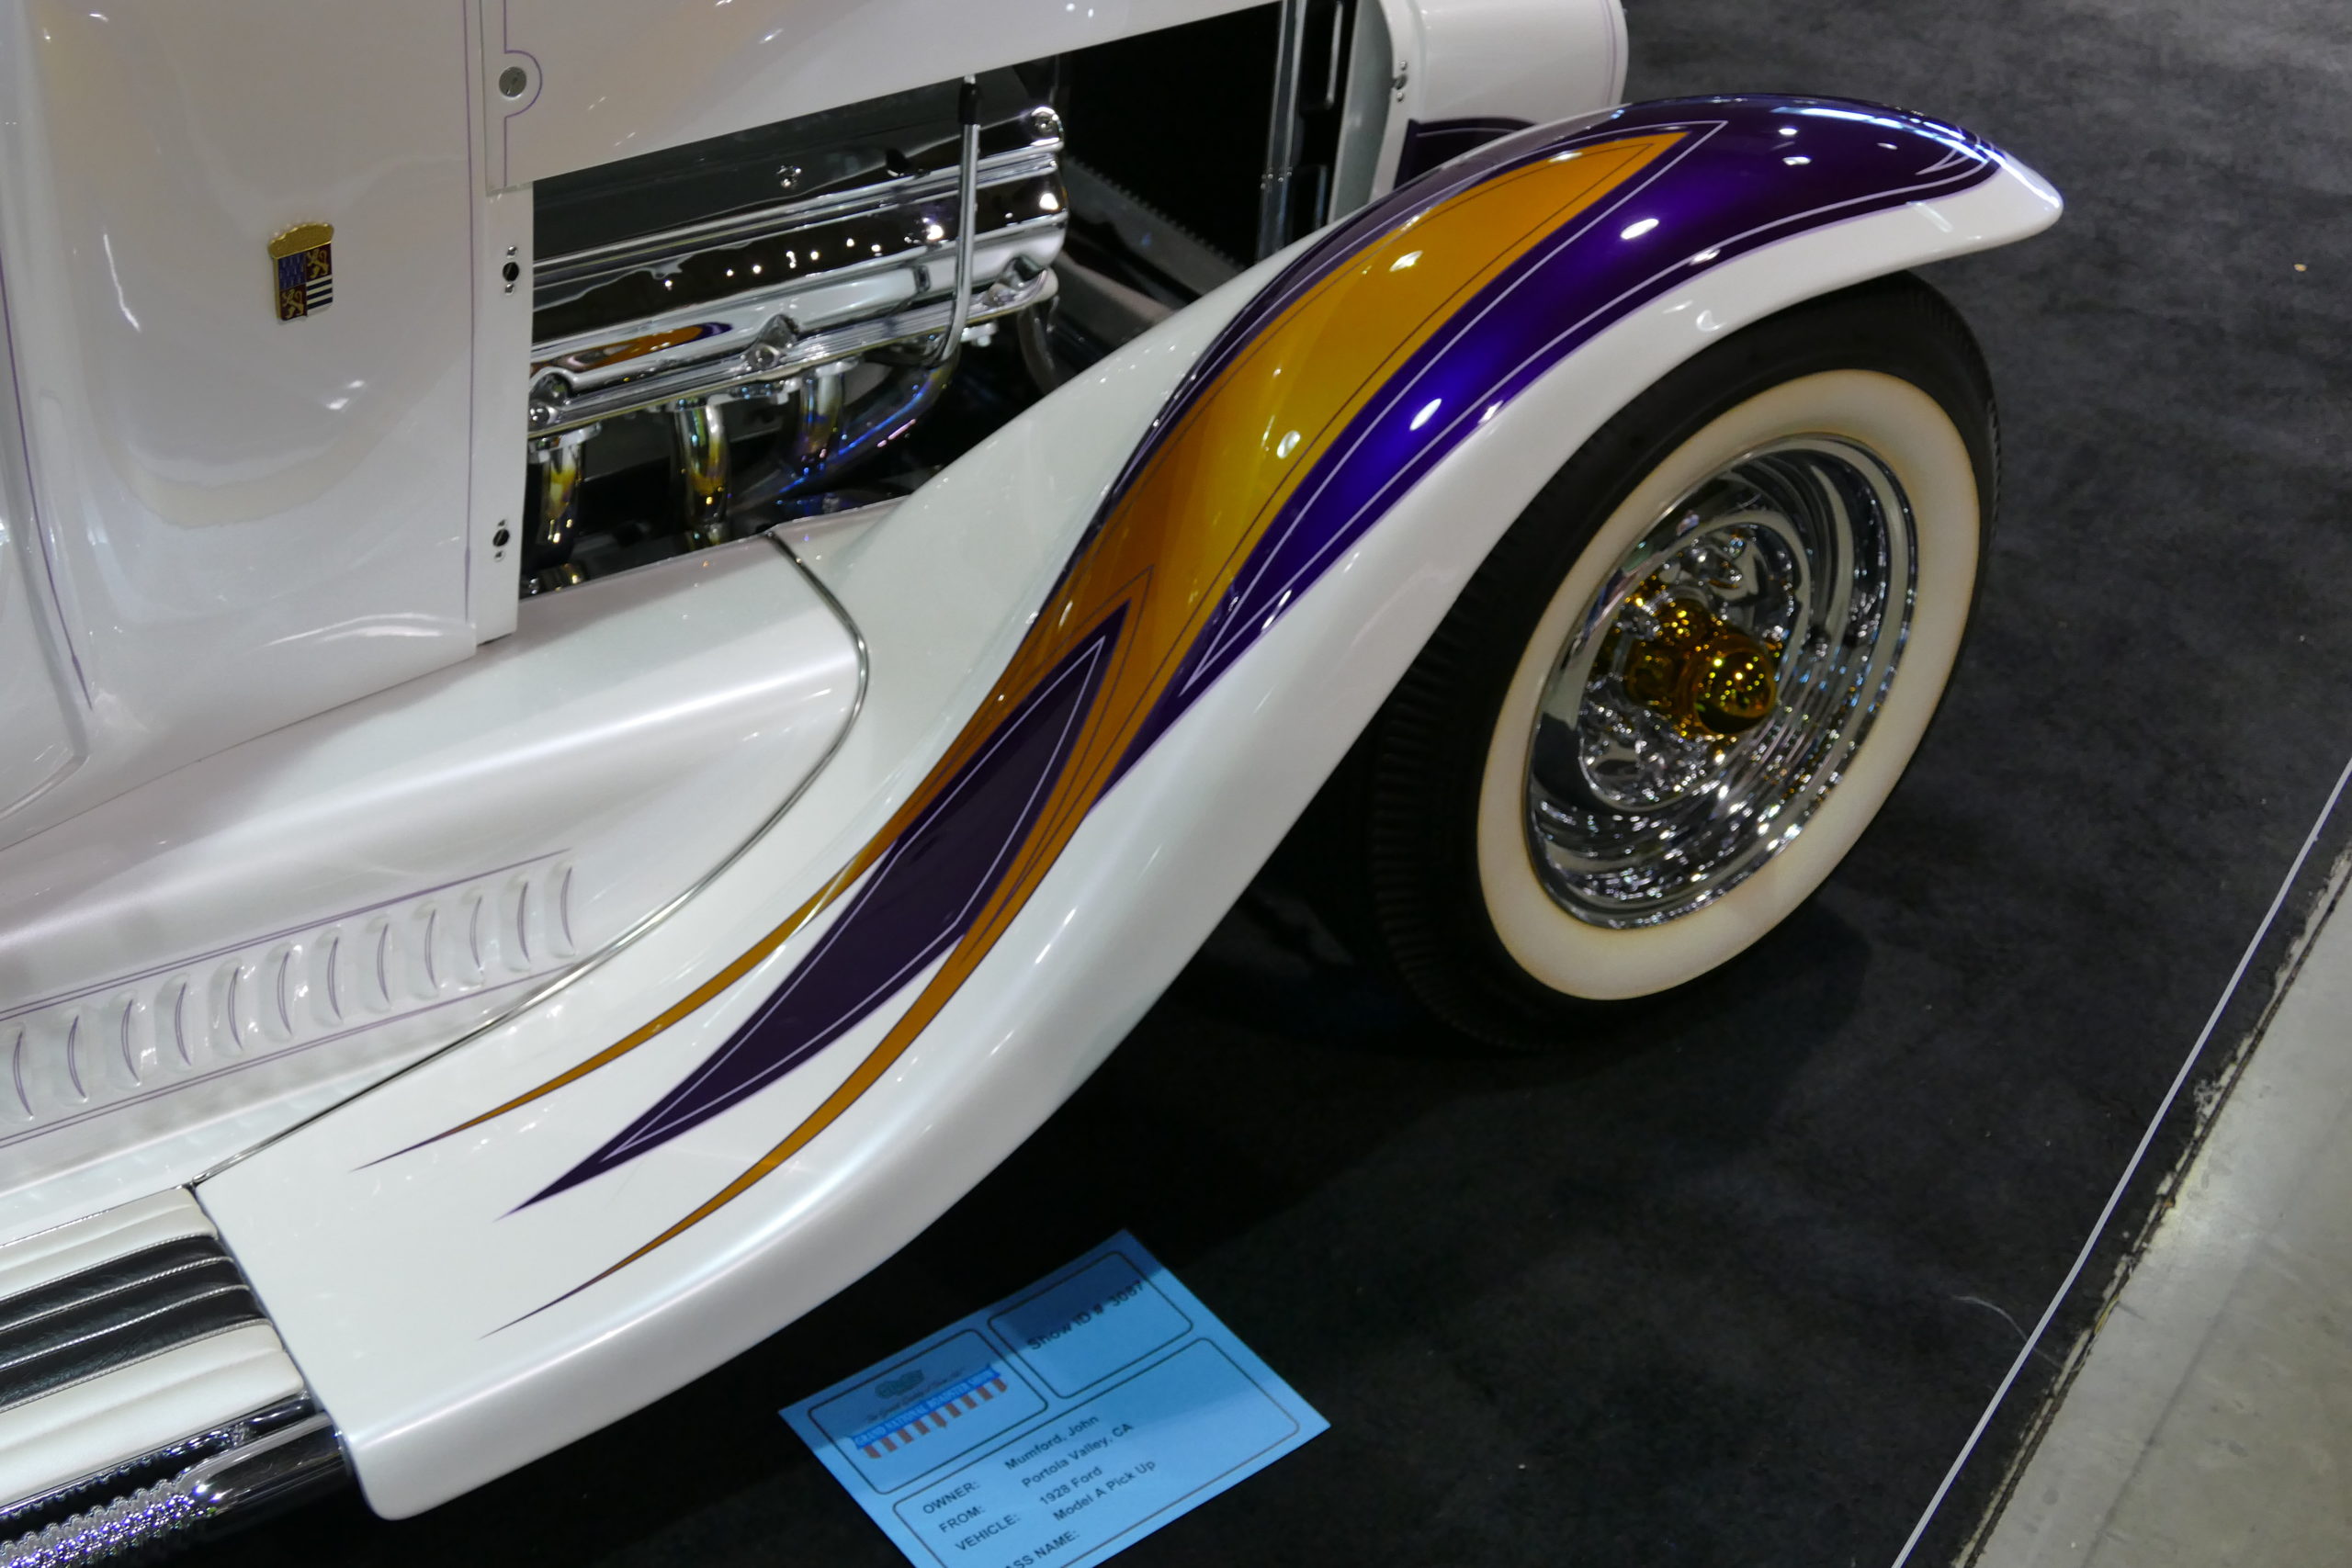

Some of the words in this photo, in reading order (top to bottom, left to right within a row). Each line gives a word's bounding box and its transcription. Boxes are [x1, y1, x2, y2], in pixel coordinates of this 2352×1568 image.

[1027, 1322, 1072, 1349] Show
[1072, 1311, 1091, 1325] ID
[1093, 1303, 1103, 1315] #
[922, 1481, 980, 1514] OWNER:
[1068, 1416, 1100, 1438] John
[939, 1506, 986, 1533] FROM:
[1022, 1458, 1070, 1488] Portola
[1068, 1437, 1114, 1461] Valley,
[1111, 1423, 1136, 1438] CA
[1053, 1495, 1094, 1521] Model
[1094, 1487, 1108, 1499] A
[1105, 1472, 1136, 1491] Pick
[1135, 1461, 1157, 1475] Up
[955, 1514, 1021, 1551] VEHICLE:
[1039, 1484, 1071, 1506] 1928
[1070, 1466, 1102, 1489] Ford
[1034, 1530, 1080, 1559] NAME:
